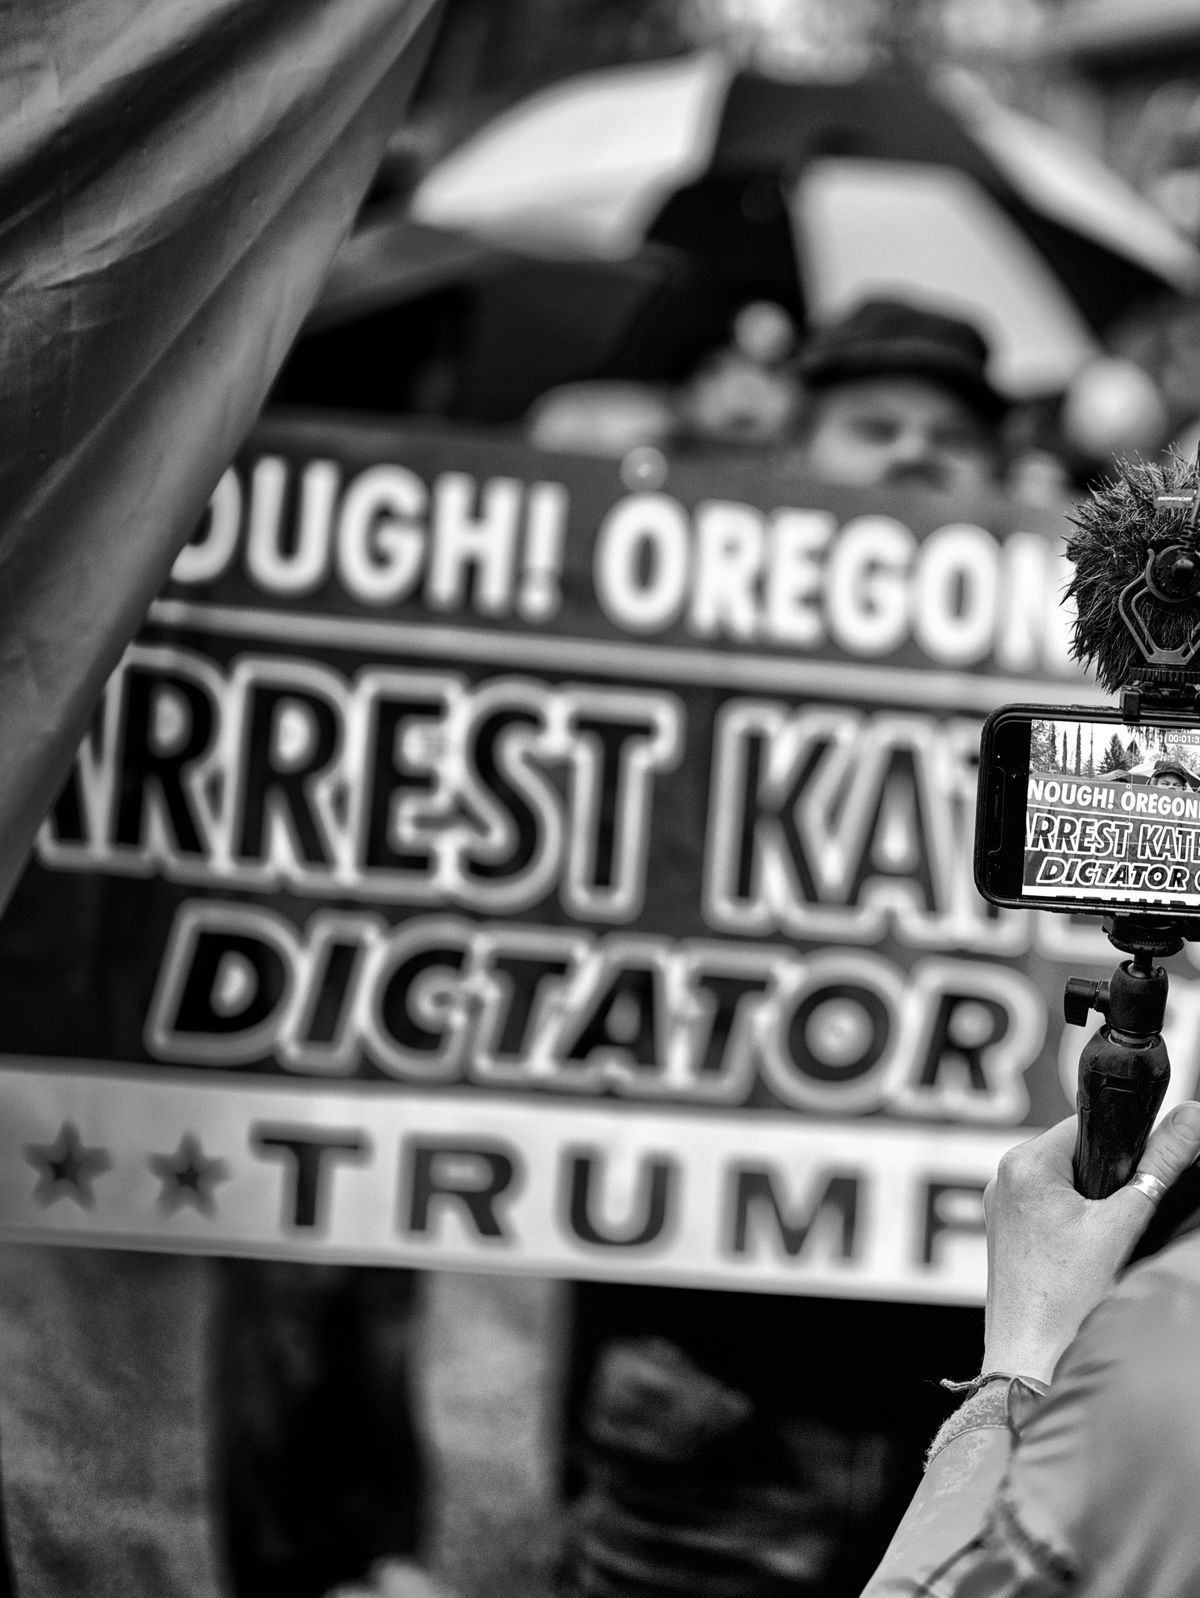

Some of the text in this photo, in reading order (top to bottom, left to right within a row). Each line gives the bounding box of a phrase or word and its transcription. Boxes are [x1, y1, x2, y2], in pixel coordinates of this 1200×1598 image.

[1024, 811, 1133, 857] RREST
[1036, 856, 1190, 891] DICTATOR
[142, 898, 1045, 1126] DICTATOR
